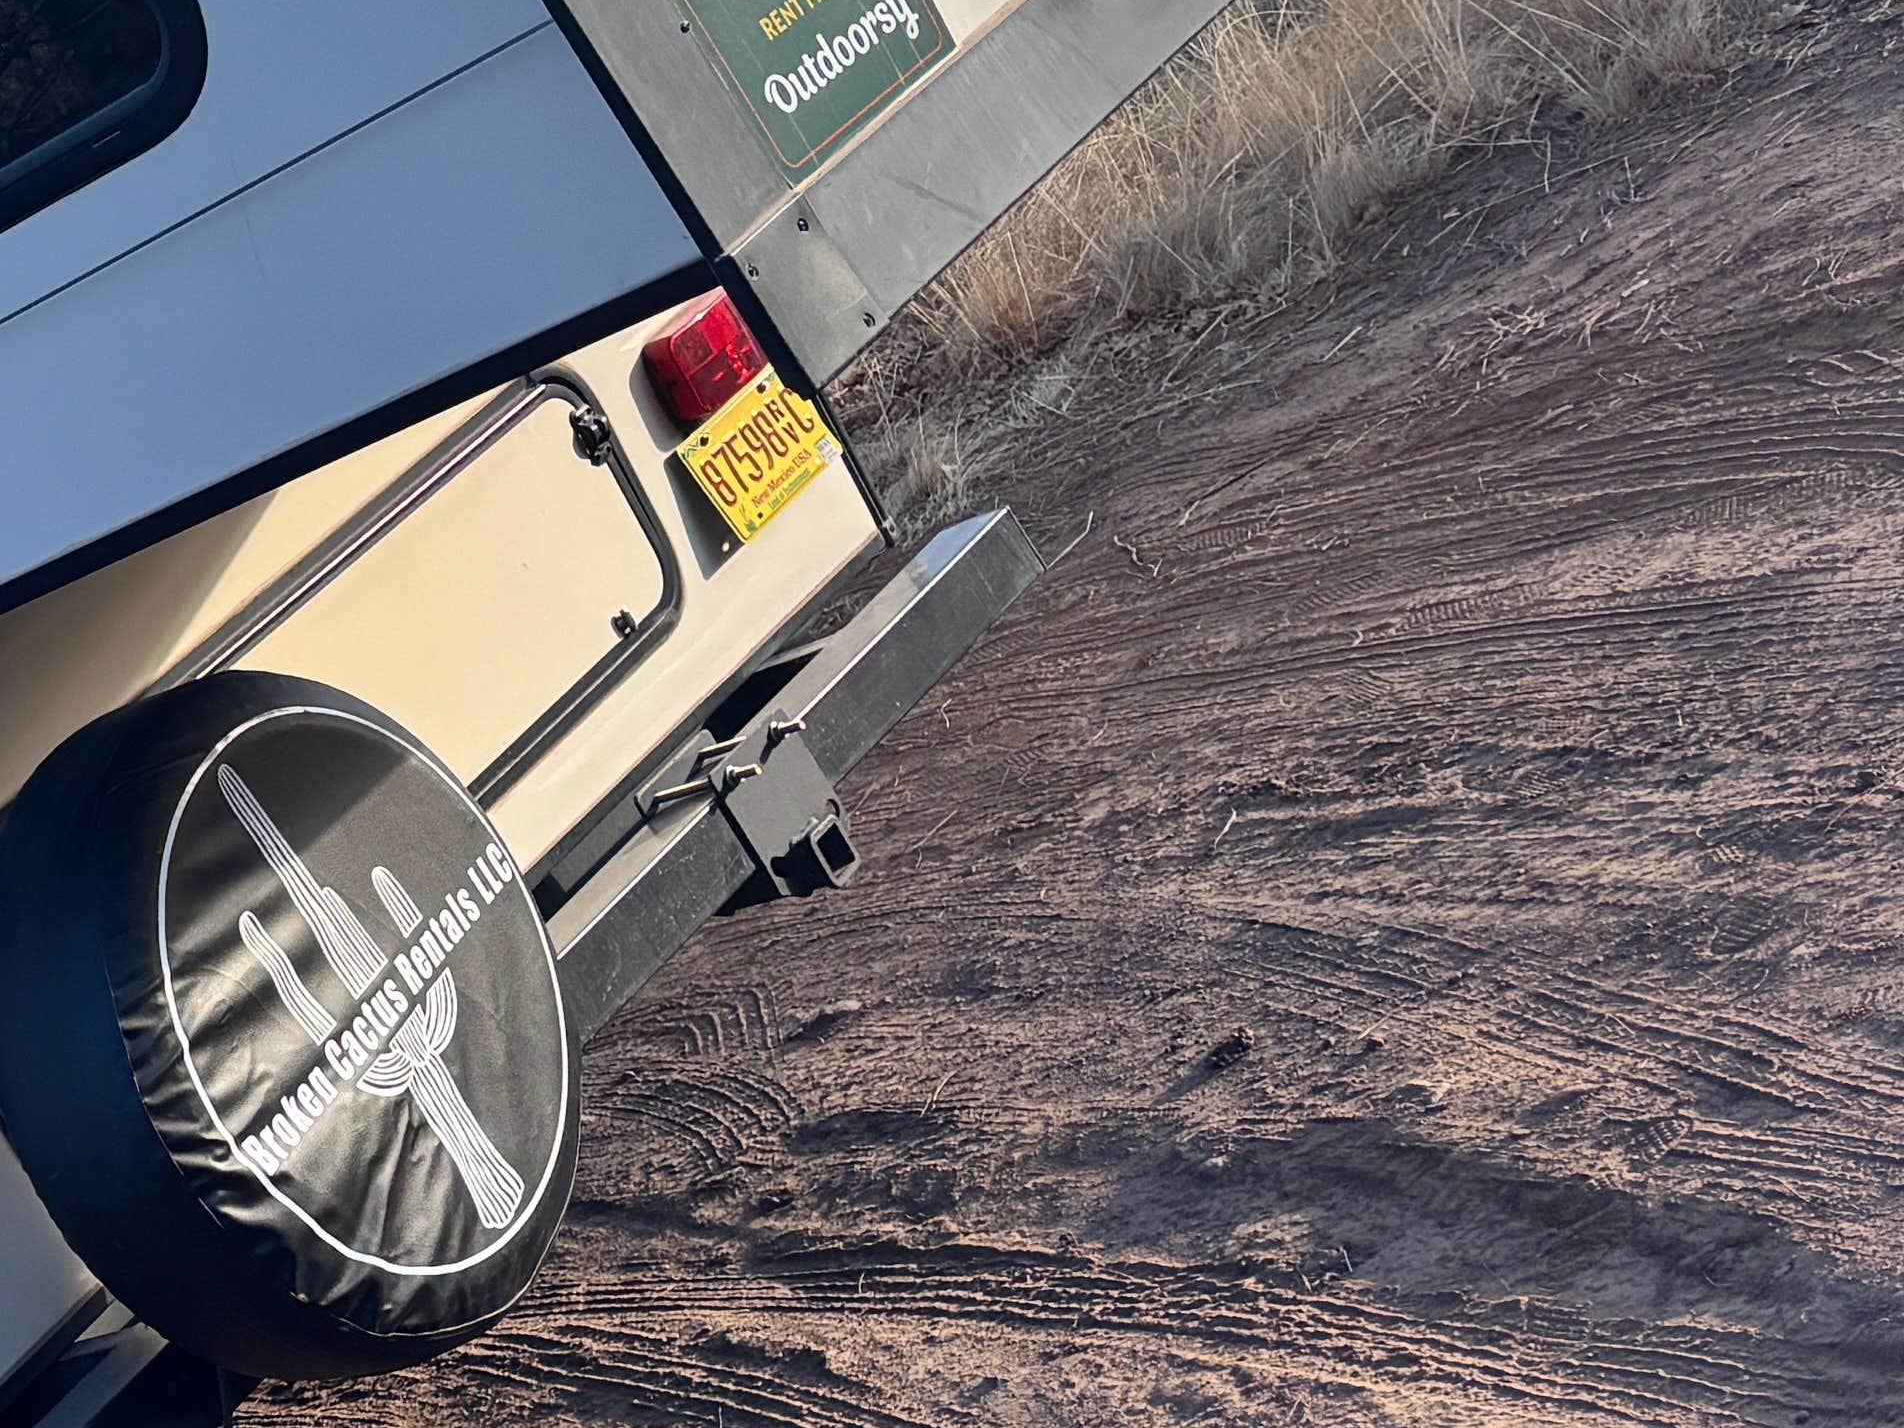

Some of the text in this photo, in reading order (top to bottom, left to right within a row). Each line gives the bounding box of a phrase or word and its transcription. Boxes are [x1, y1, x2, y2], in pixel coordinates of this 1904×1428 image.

[792, 448, 812, 468] USA
[241, 842, 514, 1177] Broken Cactus Rentals LLC
